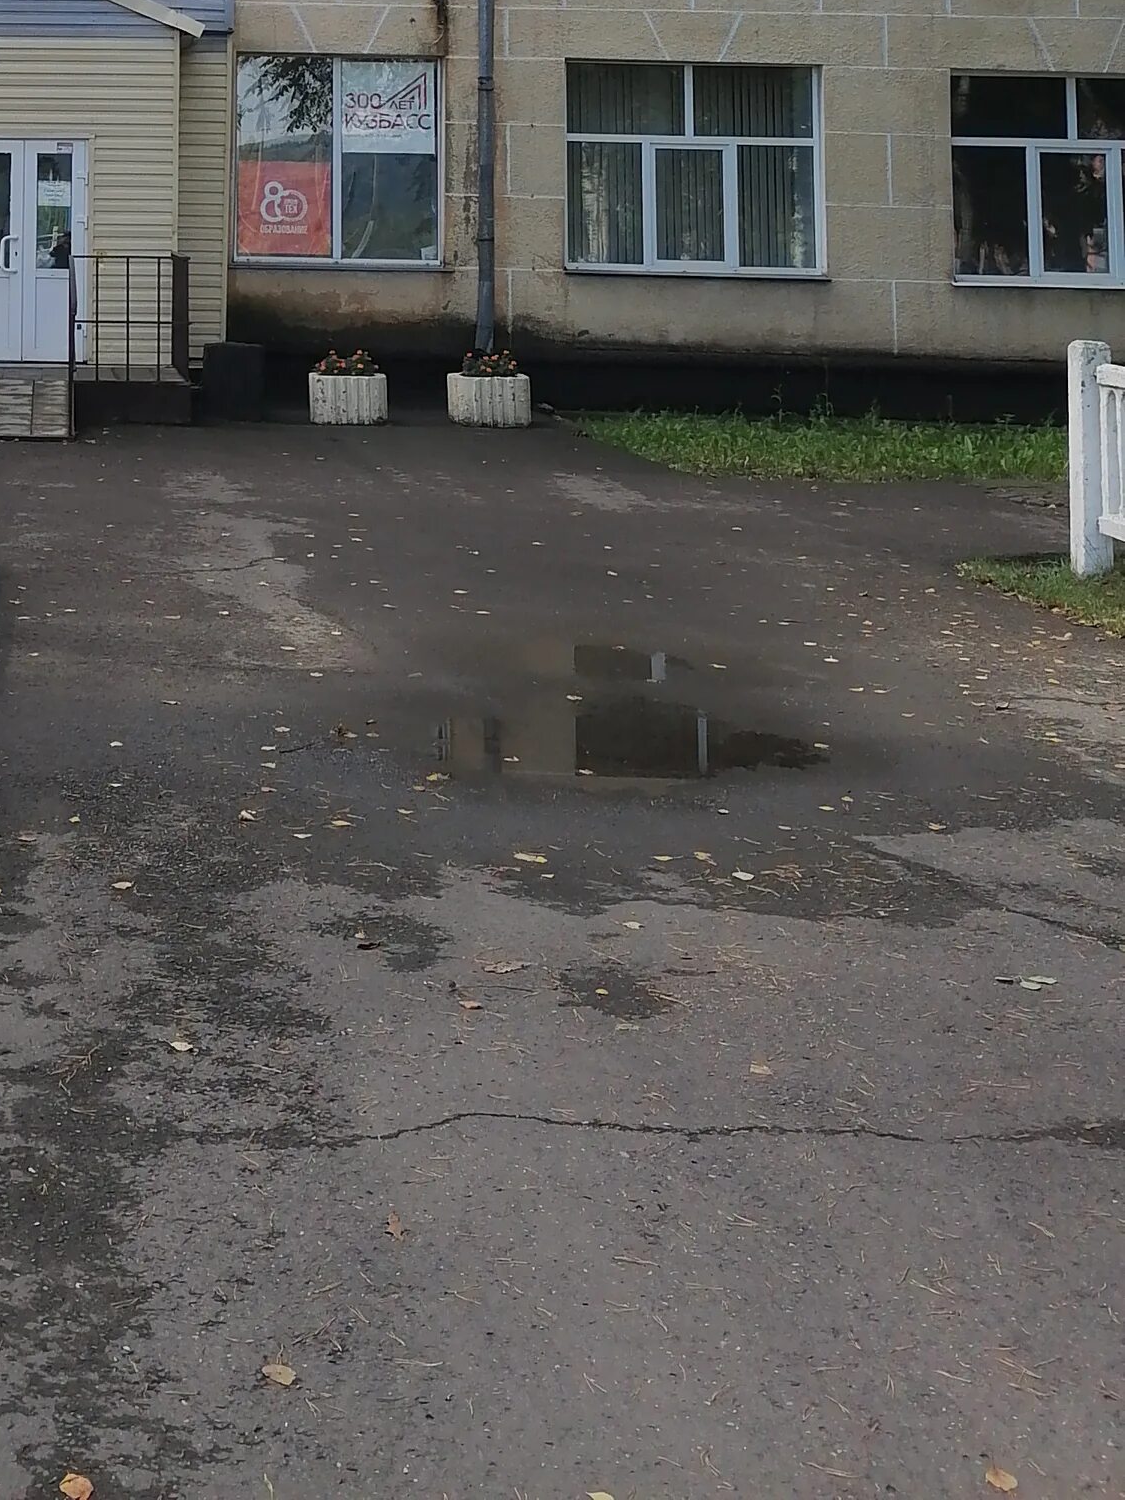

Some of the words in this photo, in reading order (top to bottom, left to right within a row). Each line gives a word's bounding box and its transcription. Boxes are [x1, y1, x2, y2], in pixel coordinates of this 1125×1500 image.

[345, 92, 383, 110] 300
[389, 100, 414, 110] ЛЕТ
[344, 113, 432, 130] КУЗБАСС
[259, 224, 308, 235] ОБРАЗОВАНИЕ
